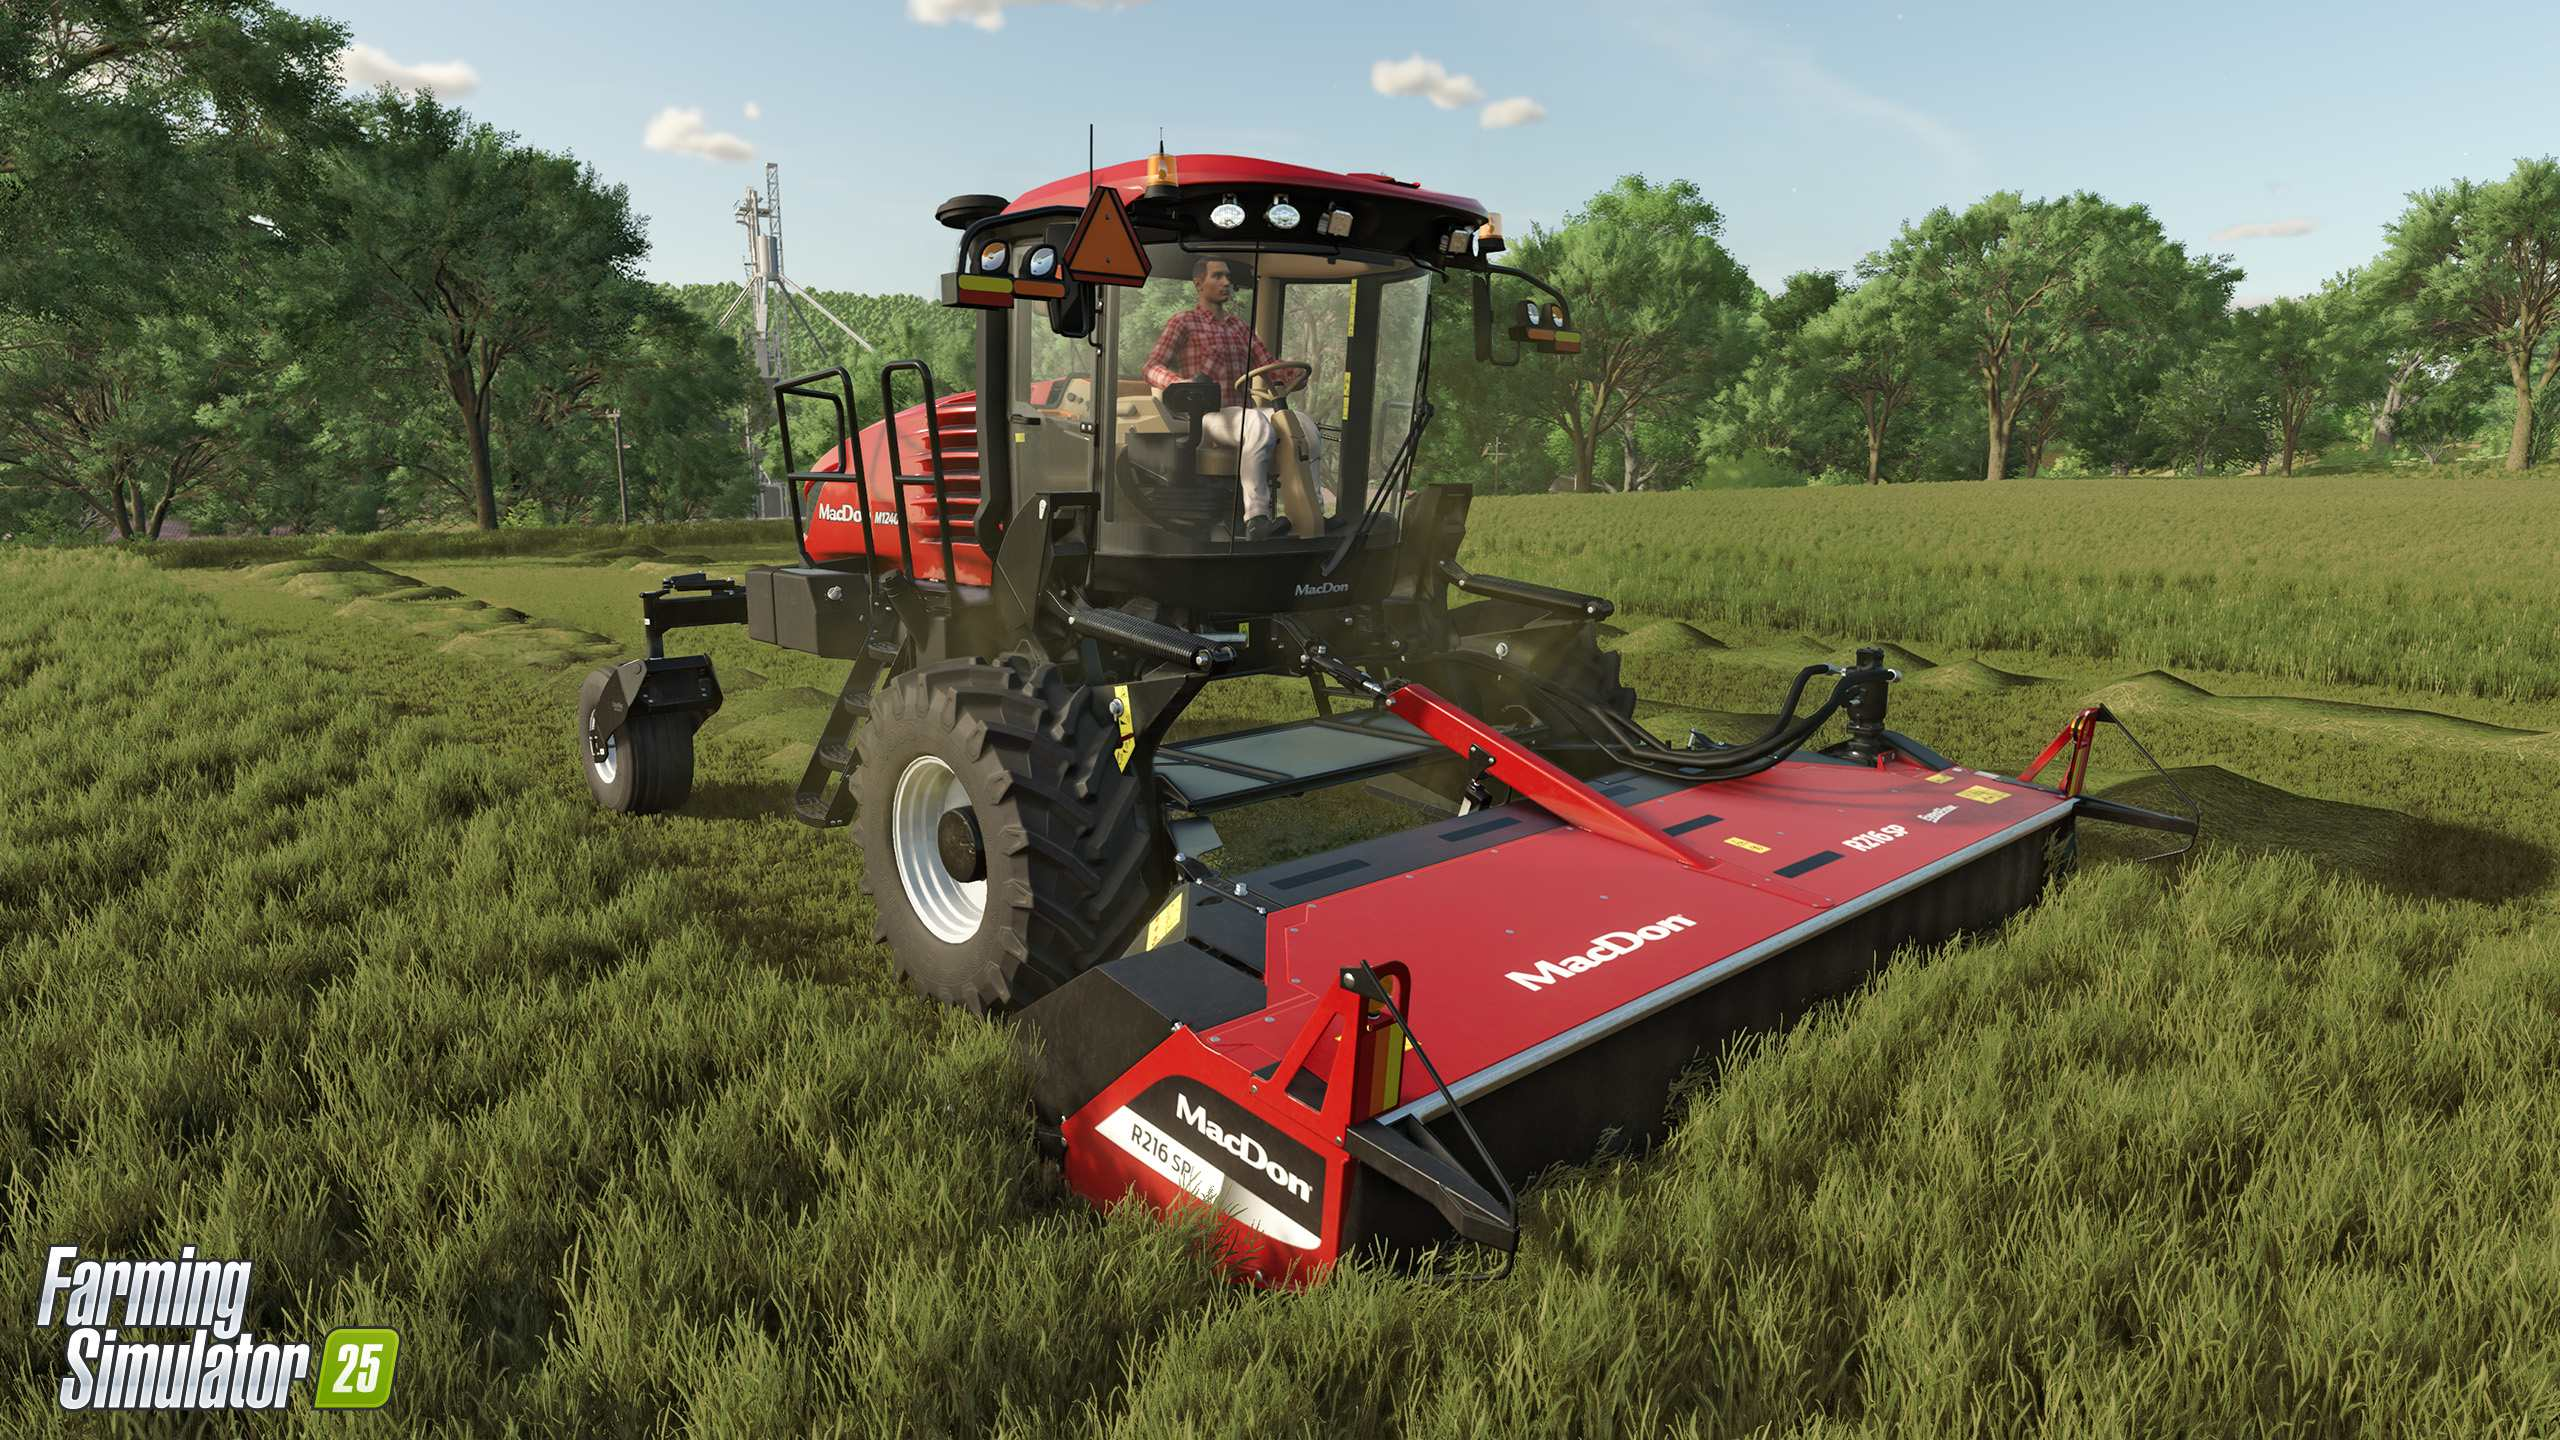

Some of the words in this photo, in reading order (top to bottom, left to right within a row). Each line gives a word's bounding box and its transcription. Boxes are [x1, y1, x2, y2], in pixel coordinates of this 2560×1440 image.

[818, 503, 862, 522] MacDo
[1294, 582, 1349, 596] MacDon
[1841, 830, 1894, 852] R216
[1880, 824, 1909, 837] SP
[1504, 914, 1697, 992] MacDon
[1131, 1123, 1168, 1163] R216
[1171, 1154, 1191, 1175] SP
[1176, 1093, 1313, 1203] MacDon
